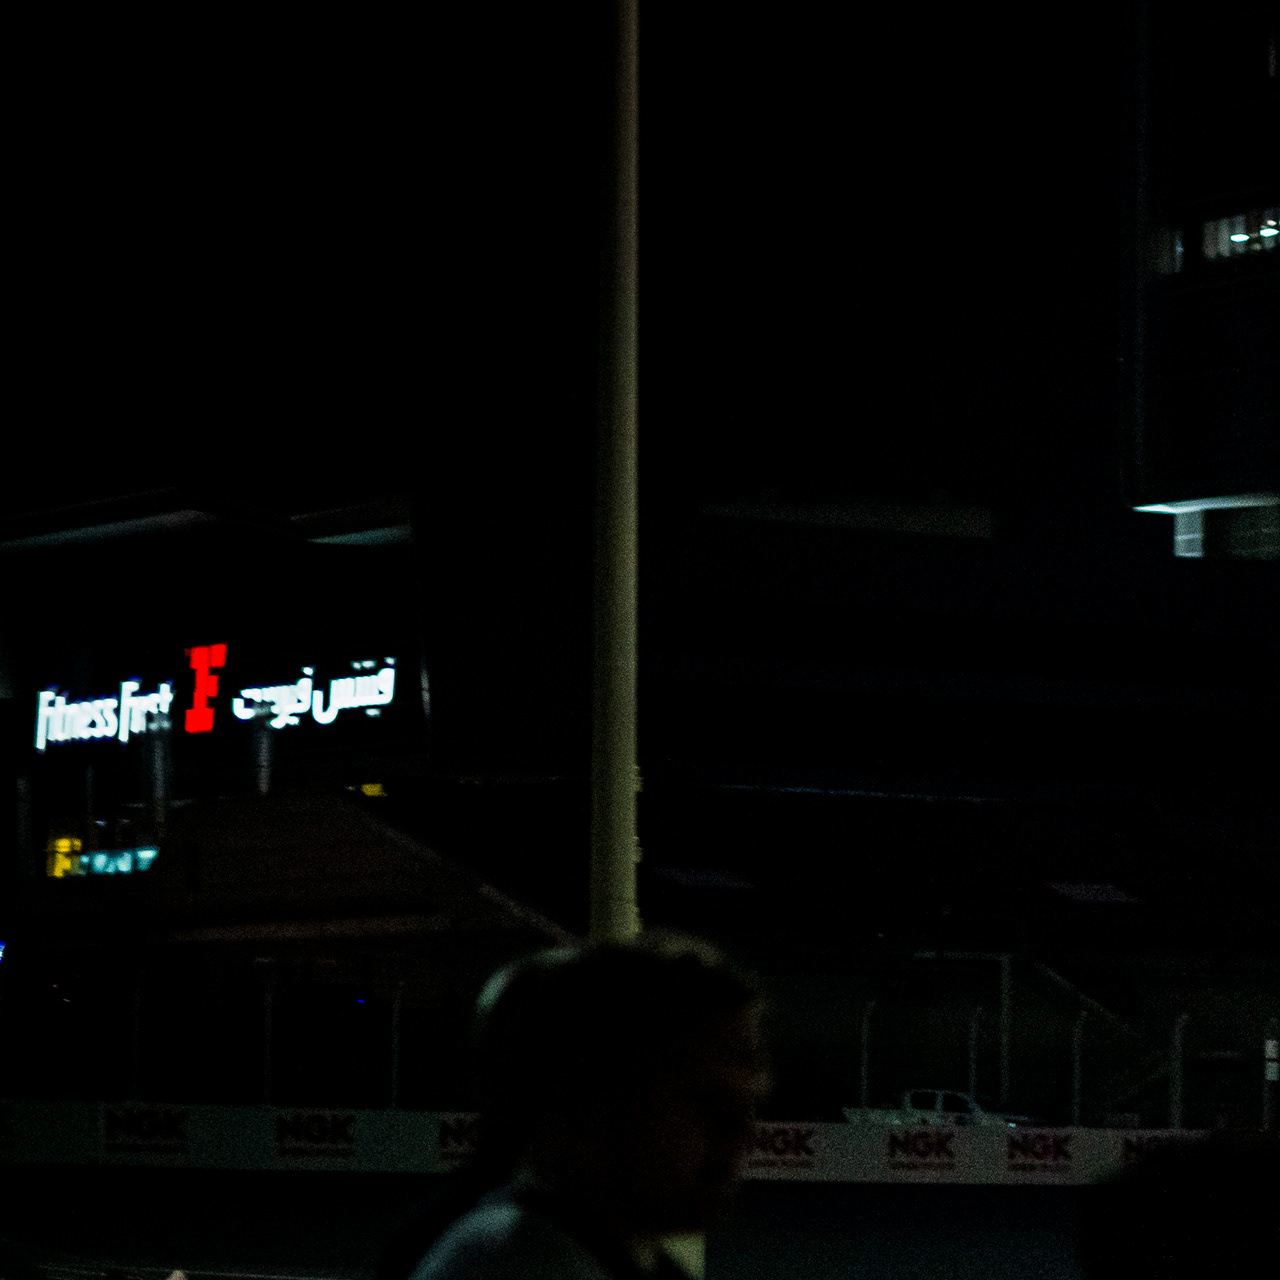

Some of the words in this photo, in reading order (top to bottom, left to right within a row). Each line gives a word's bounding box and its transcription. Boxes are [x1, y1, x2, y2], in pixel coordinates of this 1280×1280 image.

[275, 1112, 356, 1145] NGK
[888, 1130, 955, 1159] NGK
[1007, 1132, 1071, 1161] NGK
